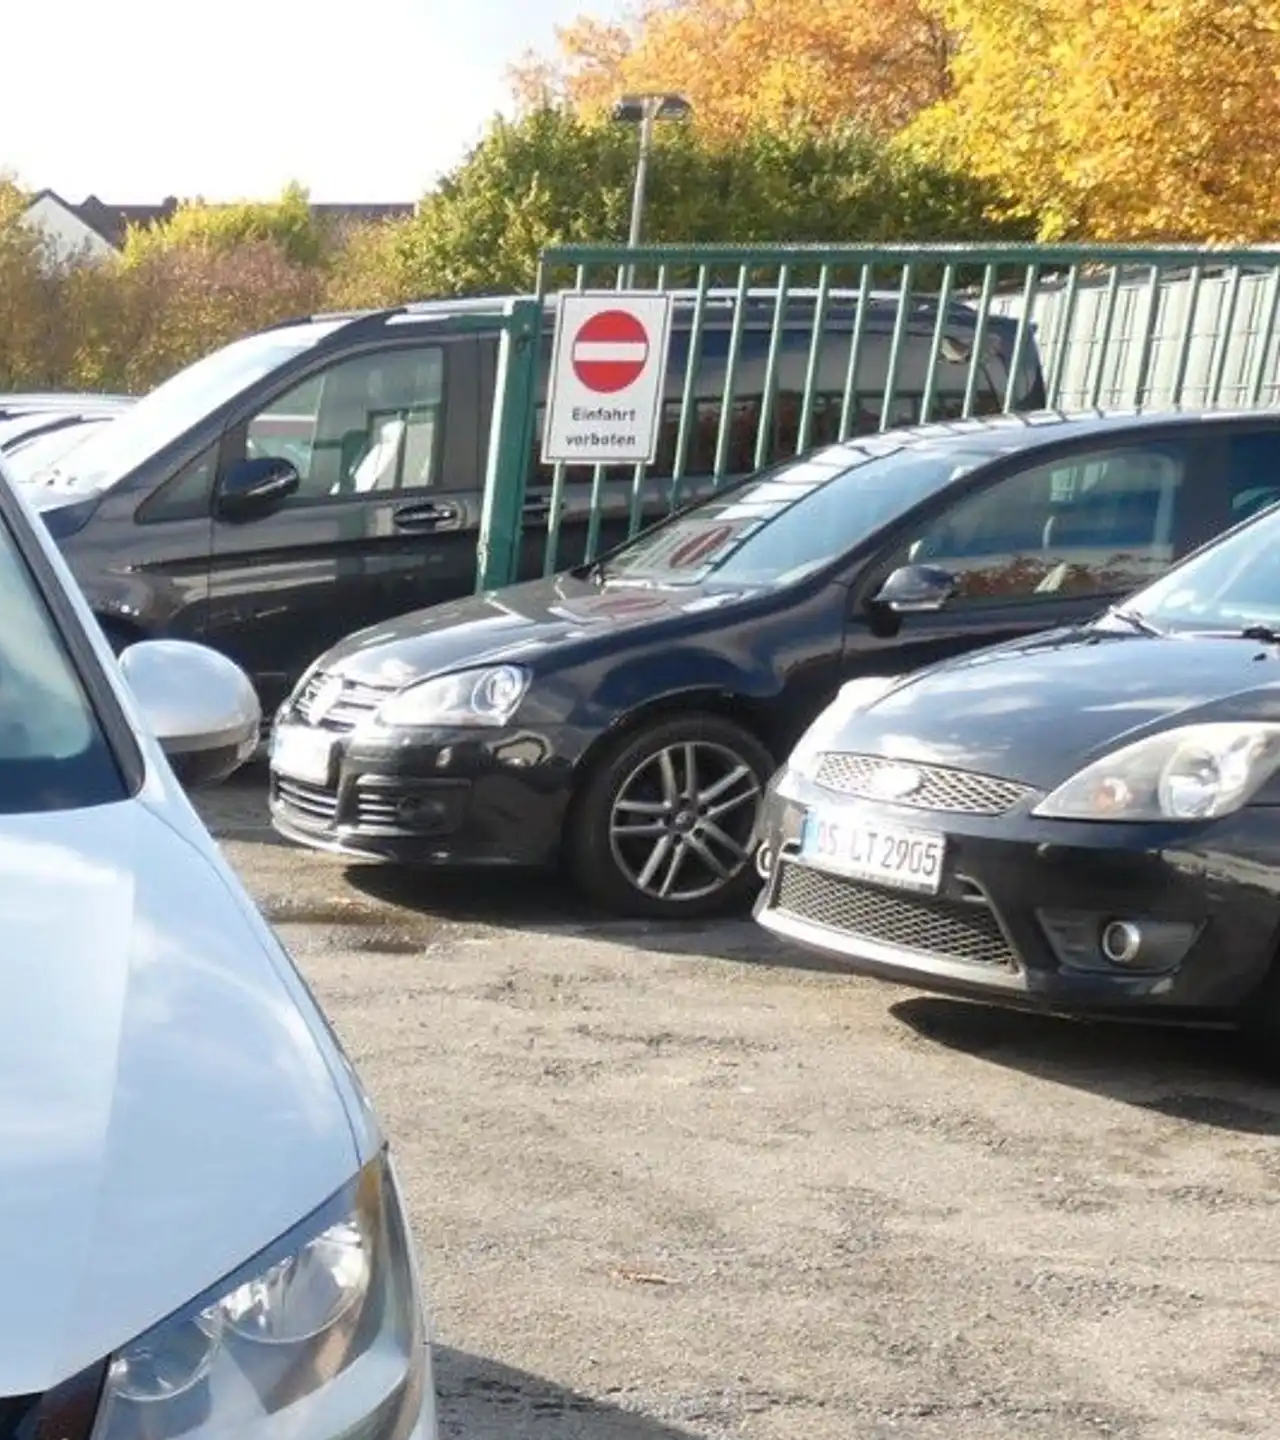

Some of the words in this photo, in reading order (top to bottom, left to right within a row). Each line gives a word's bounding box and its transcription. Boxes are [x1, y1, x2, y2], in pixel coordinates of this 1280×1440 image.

[571, 407, 637, 422] Einfahrt
[566, 433, 637, 447] verboten
[880, 834, 938, 876] 2905
